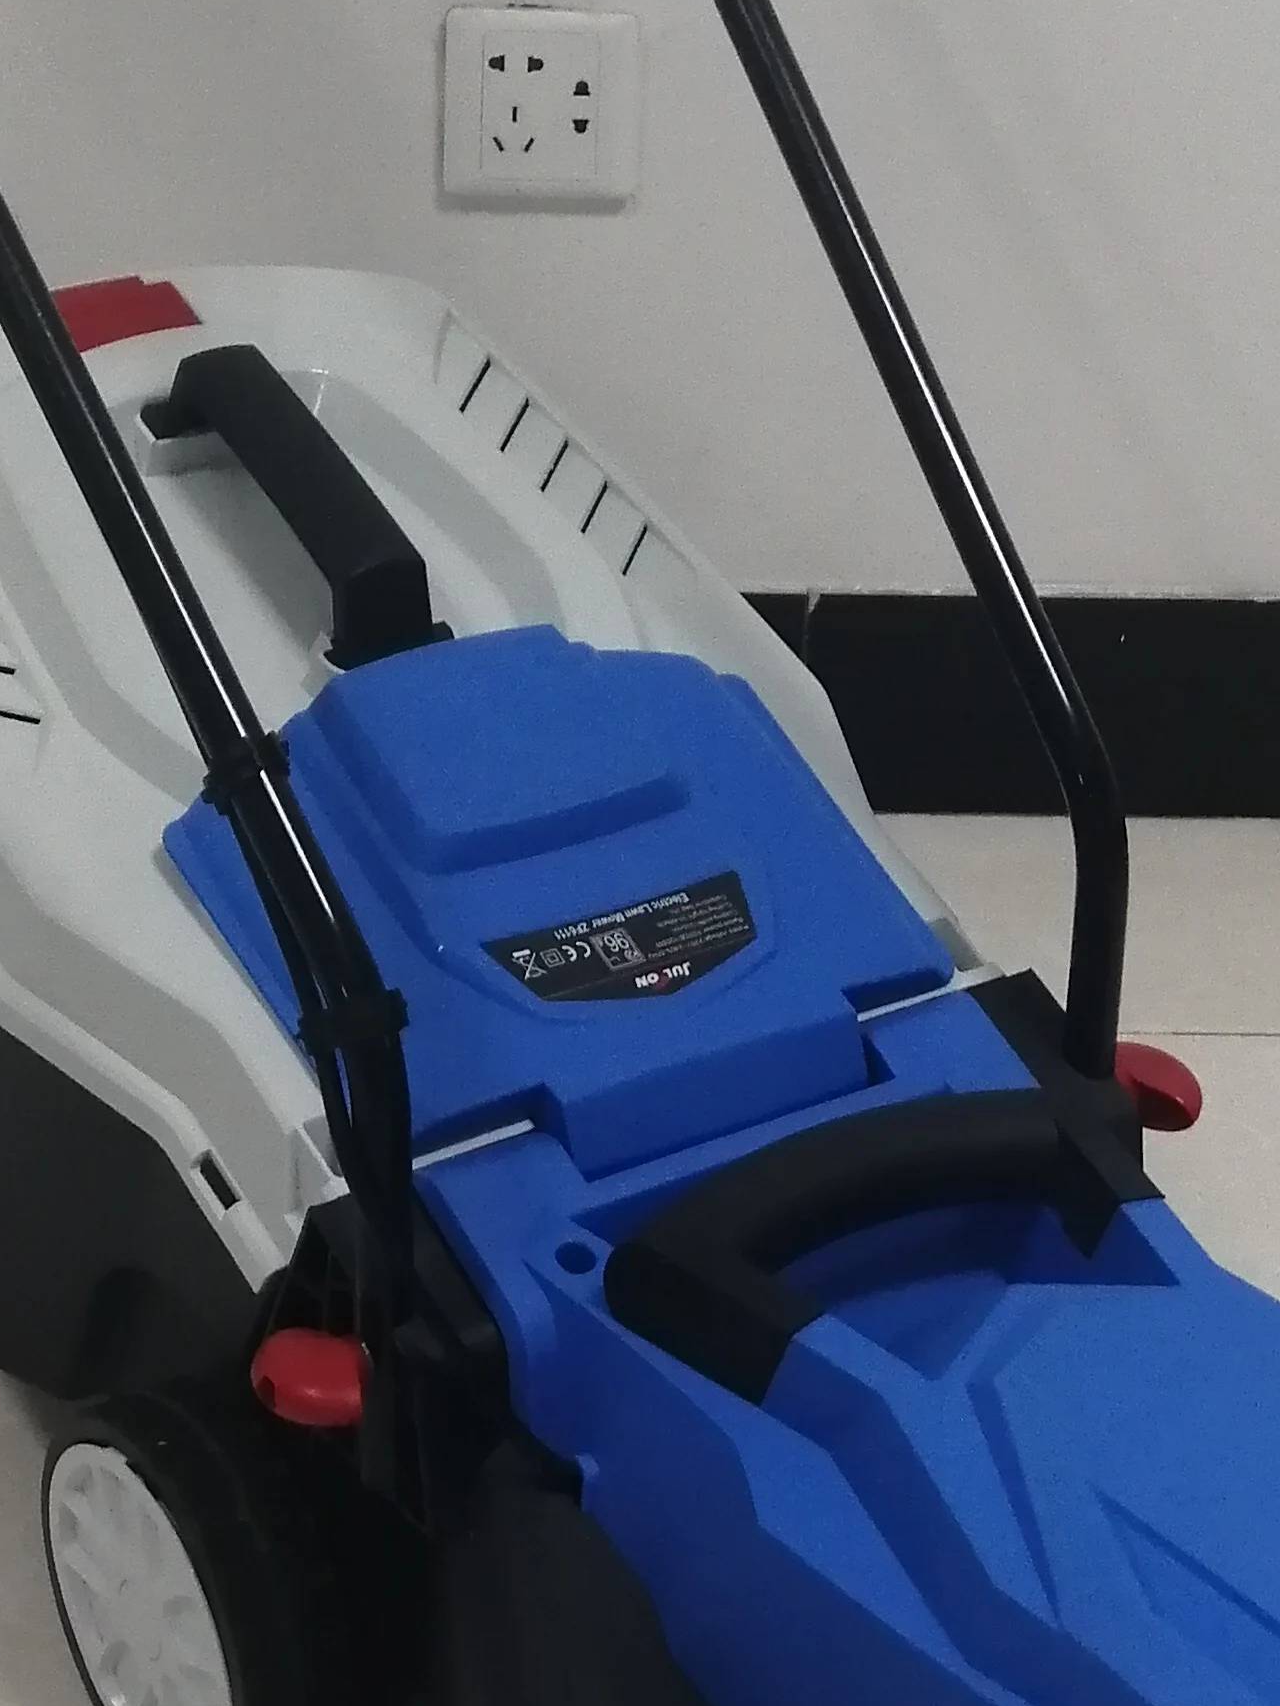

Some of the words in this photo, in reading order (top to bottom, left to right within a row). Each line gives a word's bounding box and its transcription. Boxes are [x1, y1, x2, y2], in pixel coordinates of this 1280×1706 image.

[651, 892, 690, 909] Electric
[624, 903, 653, 918] Lawn
[592, 912, 626, 929] Mower
[561, 941, 591, 962] CE
